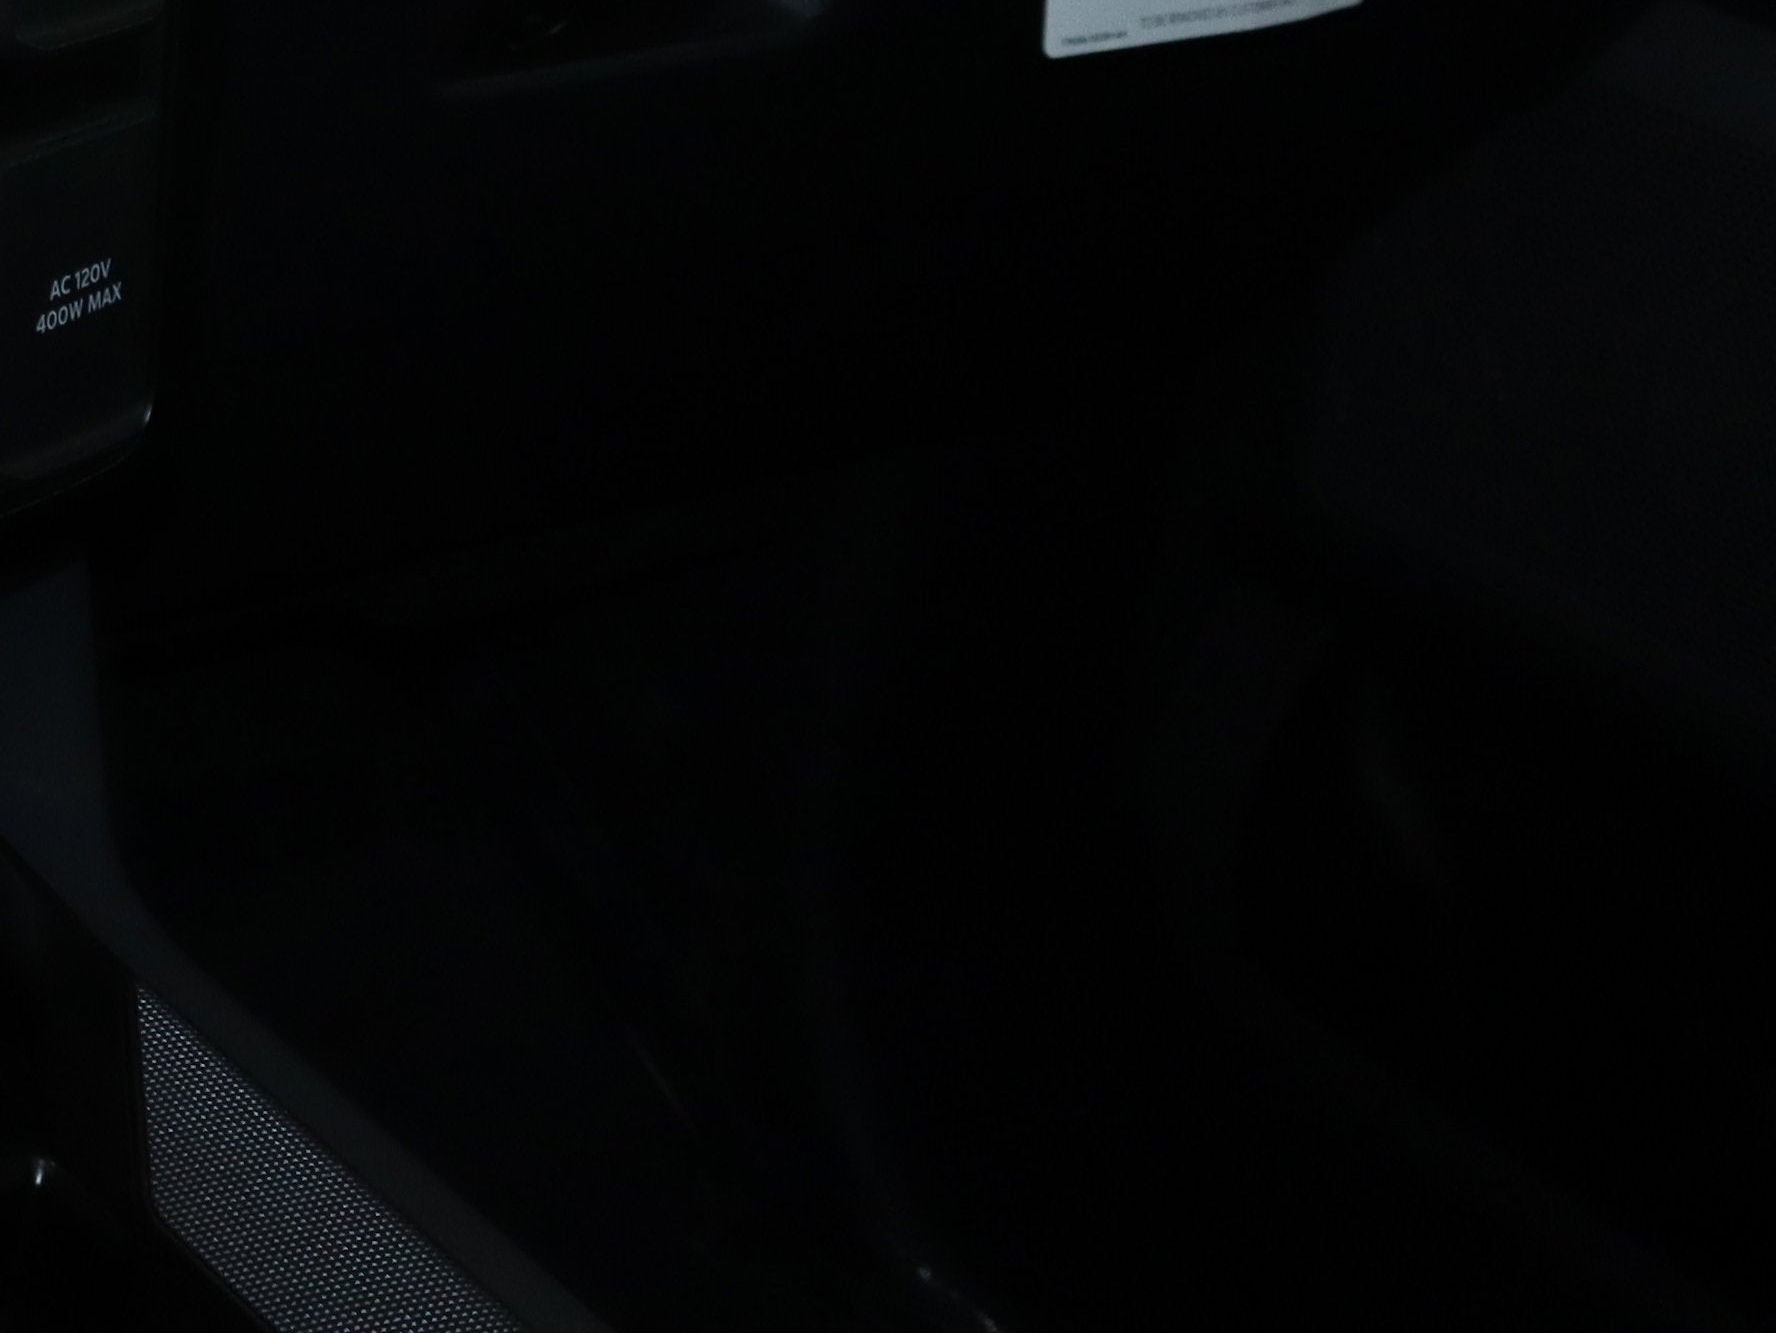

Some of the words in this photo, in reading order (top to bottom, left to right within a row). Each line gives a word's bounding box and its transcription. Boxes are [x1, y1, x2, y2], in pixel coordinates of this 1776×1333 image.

[48, 272, 72, 300] AC
[74, 257, 113, 290] 120V
[35, 298, 85, 335] 400W
[87, 280, 124, 314] MAX
